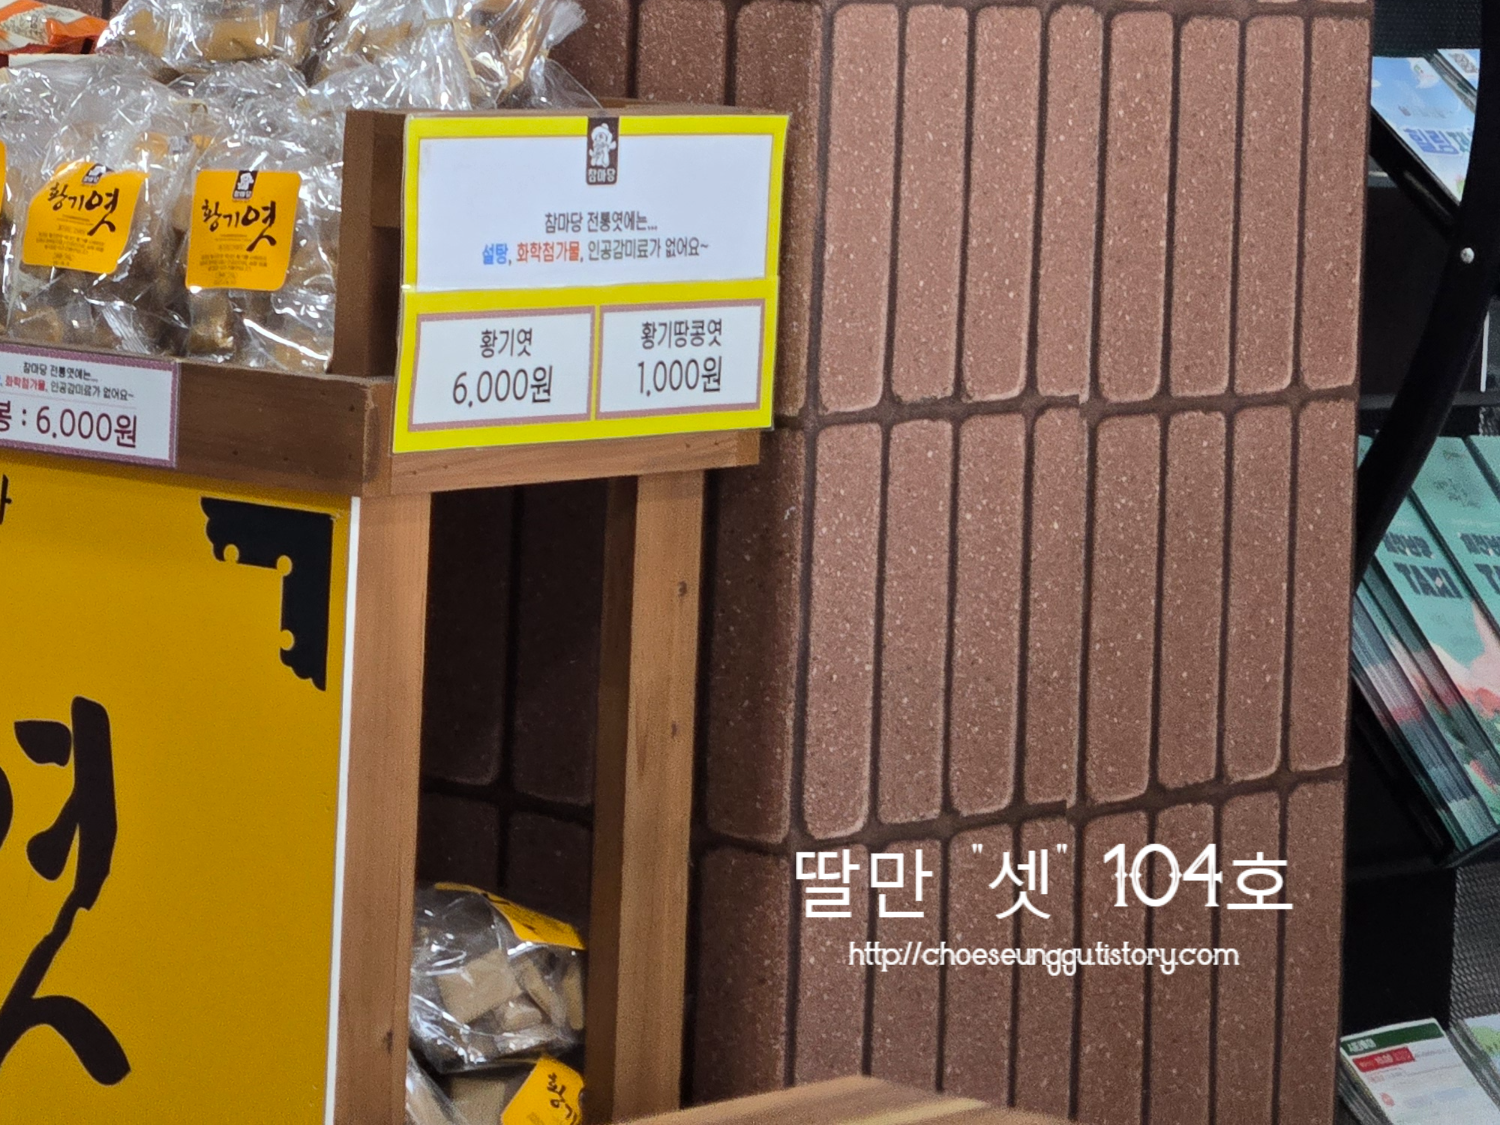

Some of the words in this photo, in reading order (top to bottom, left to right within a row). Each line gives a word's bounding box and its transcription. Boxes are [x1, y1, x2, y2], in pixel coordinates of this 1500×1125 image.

[48, 182, 120, 237] 황기엿
[202, 199, 277, 253] 황기엿
[545, 212, 583, 234] 참마당
[516, 240, 584, 263] 화학첨가물,
[588, 239, 662, 262] 인공감미료가
[479, 327, 533, 359] 황기엿
[640, 318, 723, 349] 황기땅콩엿
[23, 361, 47, 376] 참마당
[1392, 561, 1464, 599] TAXI
